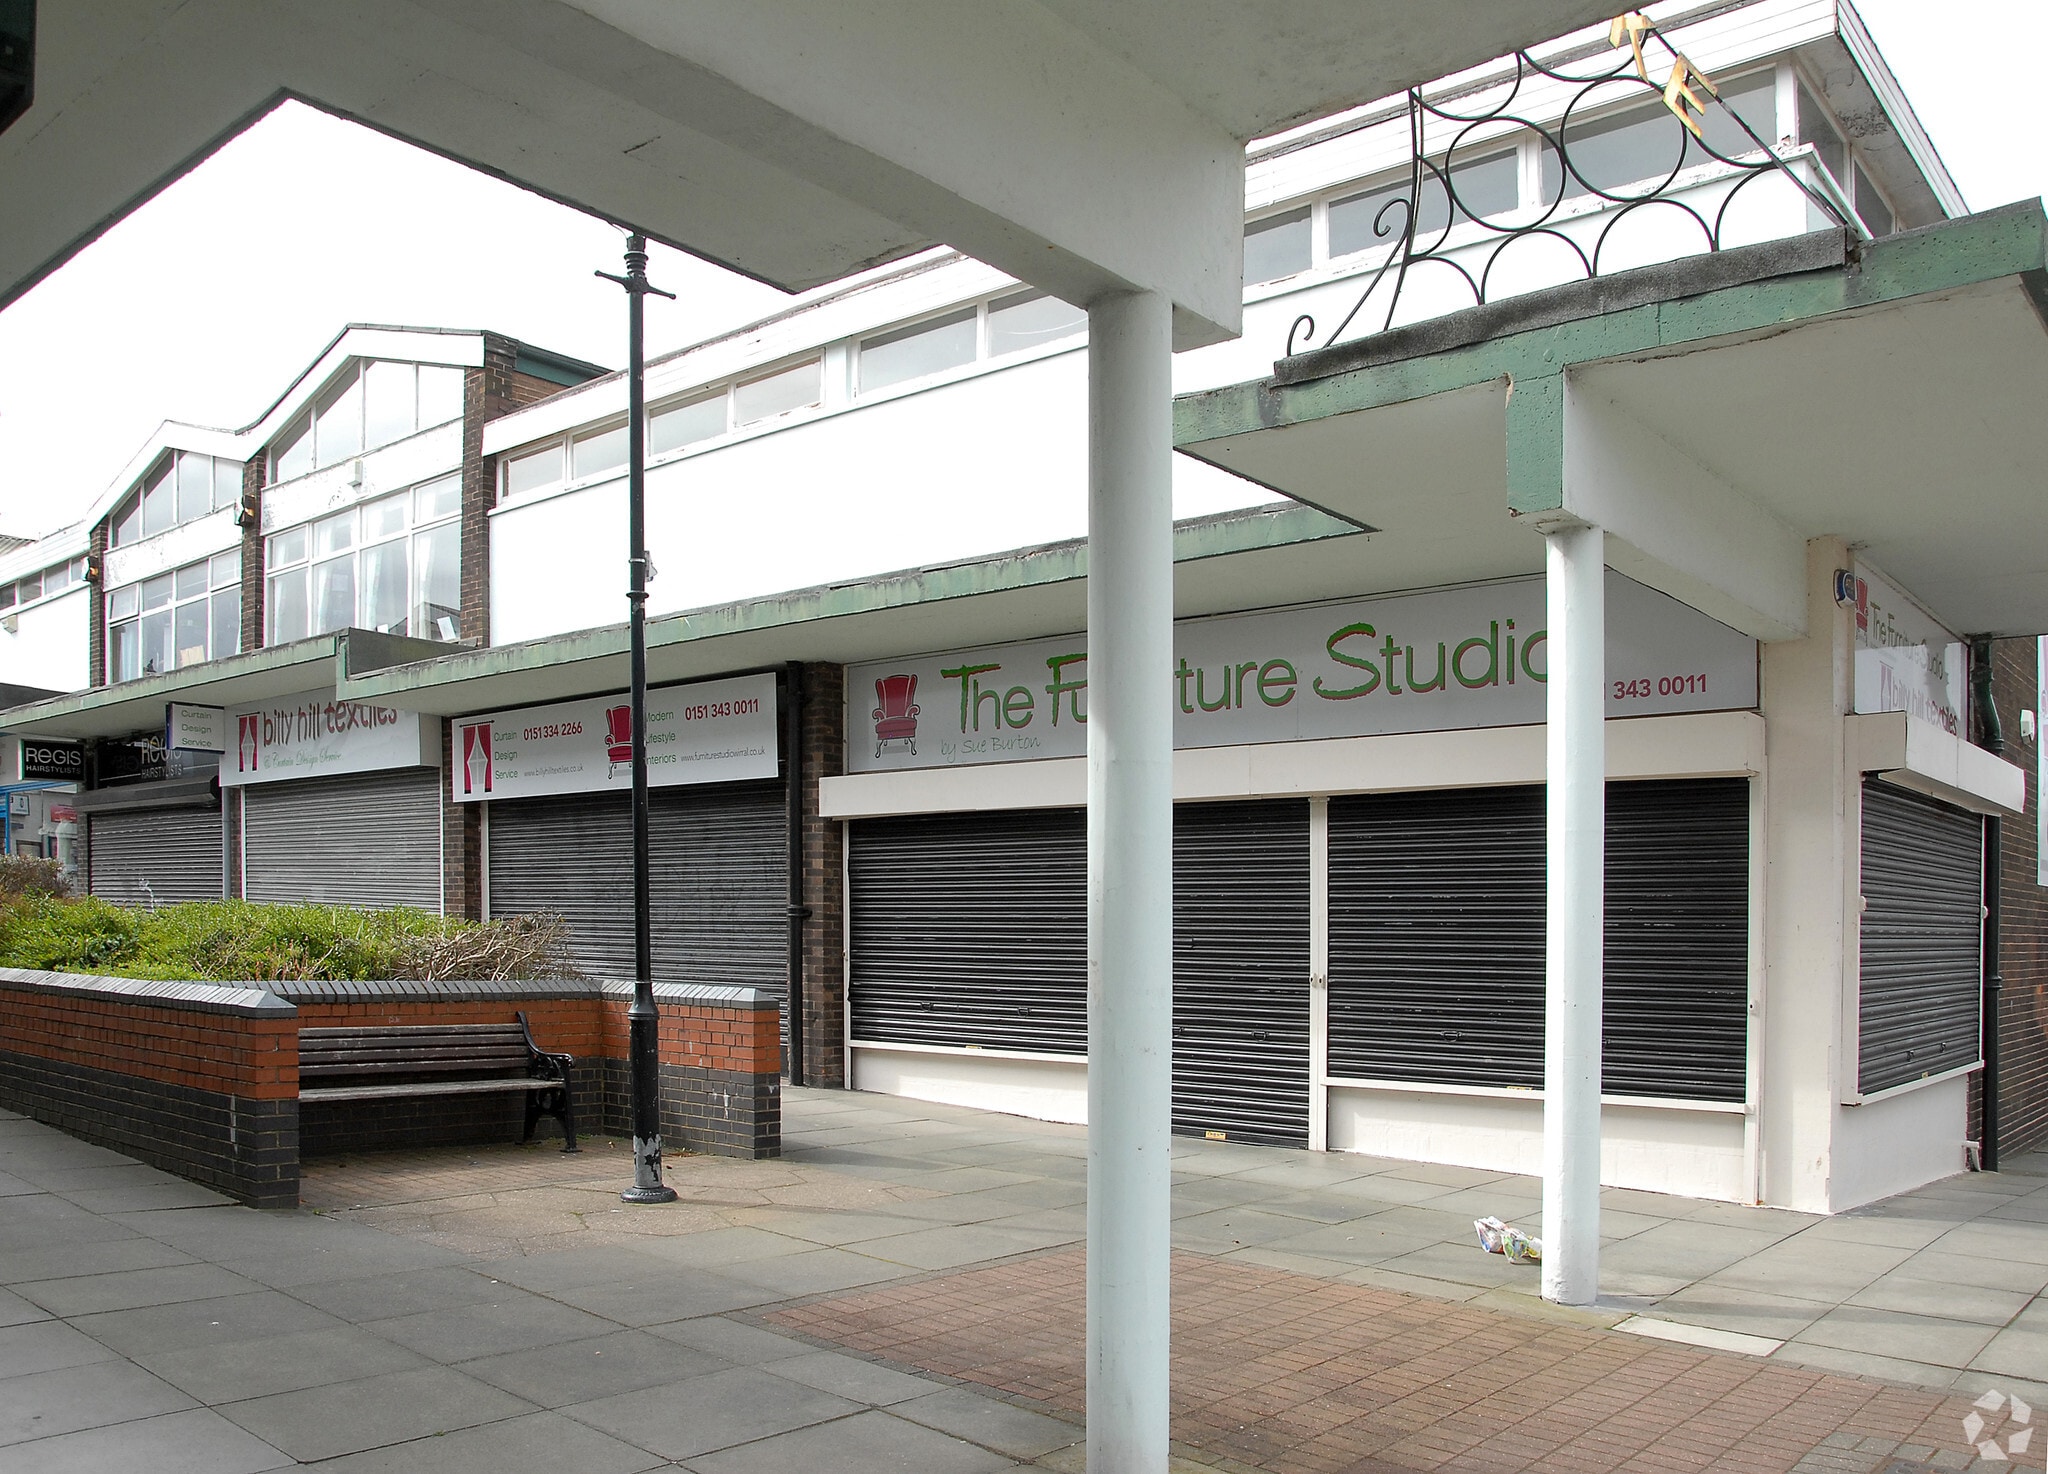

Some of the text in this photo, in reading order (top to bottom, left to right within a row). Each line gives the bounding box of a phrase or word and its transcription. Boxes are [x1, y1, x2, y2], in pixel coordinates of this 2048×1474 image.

[1613, 679, 1651, 700] 343
[1658, 674, 1706, 696] 0011
[940, 663, 1035, 734] The
[181, 709, 212, 719] Curtain
[684, 706, 708, 720] 0151
[711, 702, 731, 717] 343
[734, 698, 759, 715] 0011
[181, 723, 212, 734] Design
[263, 708, 293, 748] billy
[297, 702, 320, 743] hill
[493, 721, 583, 742] Curtain 0151 334 2266
[181, 737, 212, 747] Service
[940, 734, 1041, 763] by Sue Burton
[494, 750, 518, 762] Design
[646, 753, 677, 765] nteriors
[26, 764, 81, 775] HAIRSTYLISTS
[495, 769, 519, 780] Service
